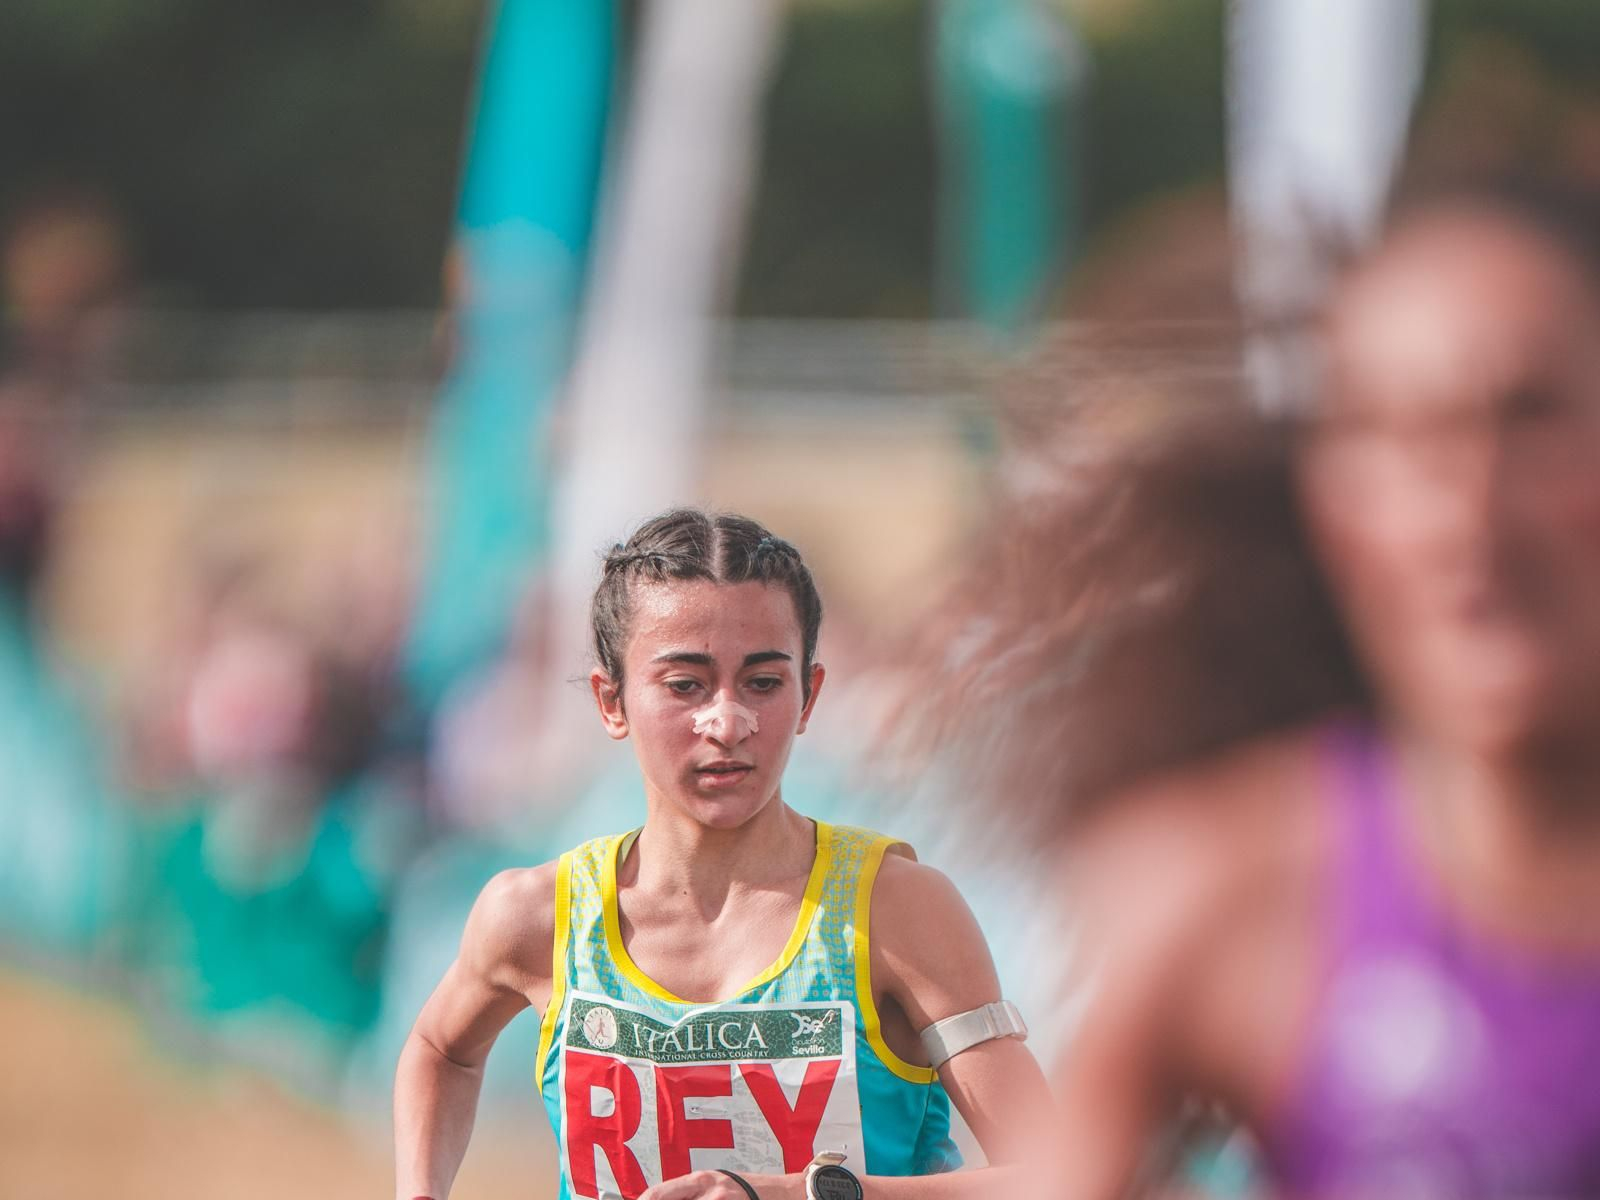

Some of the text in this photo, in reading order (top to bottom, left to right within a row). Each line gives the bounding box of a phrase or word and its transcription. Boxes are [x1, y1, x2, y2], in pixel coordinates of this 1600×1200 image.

[635, 1049, 696, 1061] INNATIONAL
[729, 1050, 769, 1058] COUNTRY
[792, 1045, 825, 1055] Sevilla
